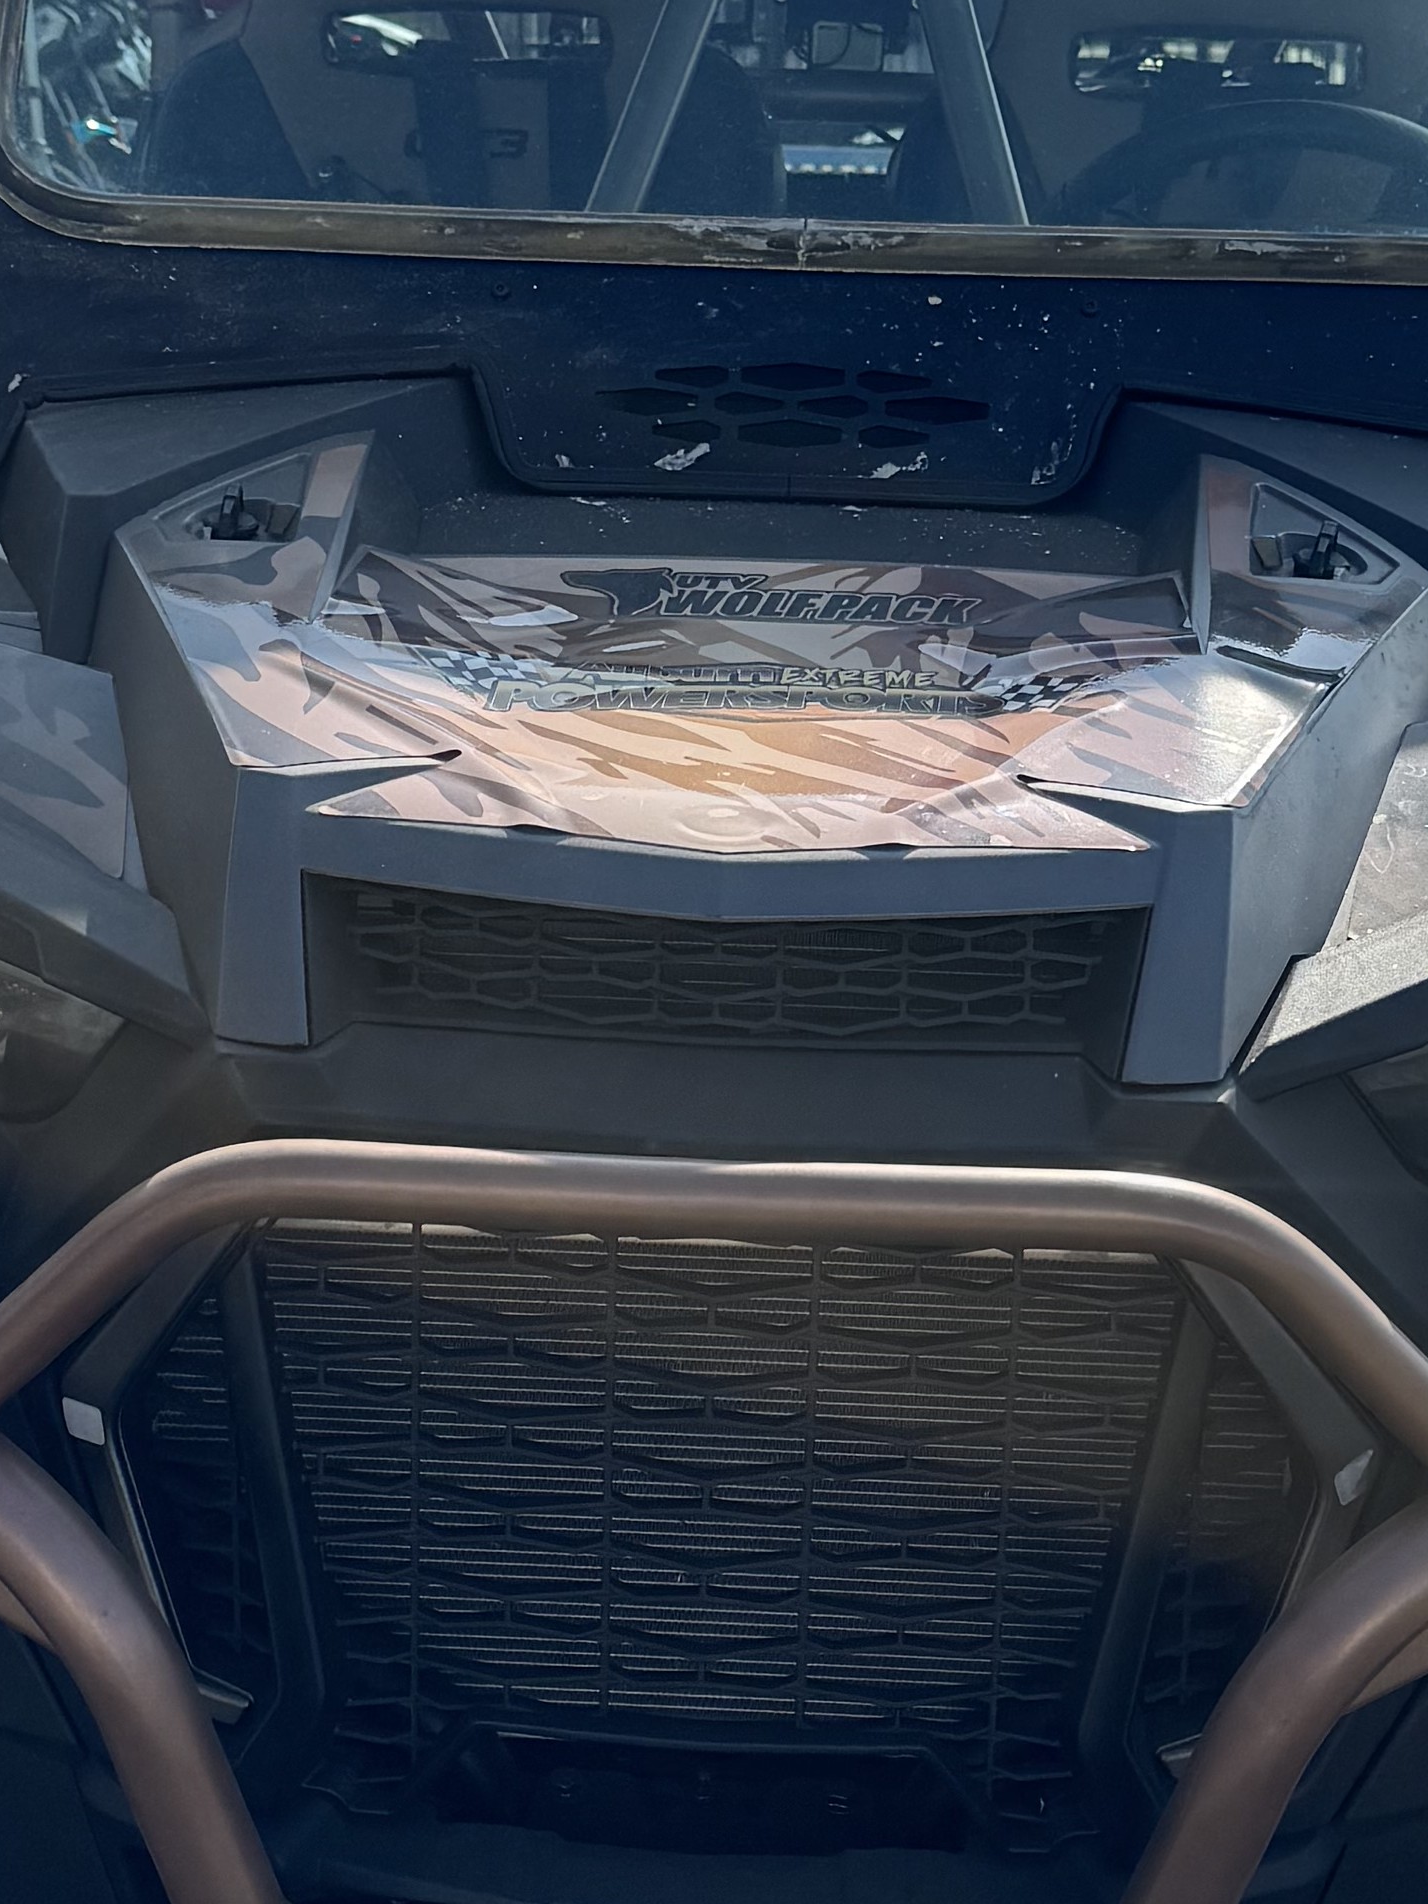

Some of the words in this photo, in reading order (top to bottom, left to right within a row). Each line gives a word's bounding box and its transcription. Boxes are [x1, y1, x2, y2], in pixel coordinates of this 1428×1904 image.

[675, 574, 765, 591] UTV
[664, 590, 981, 624] WOLFPACK
[780, 667, 938, 688] EXTREME
[486, 680, 1007, 714] POWERSPORTS
